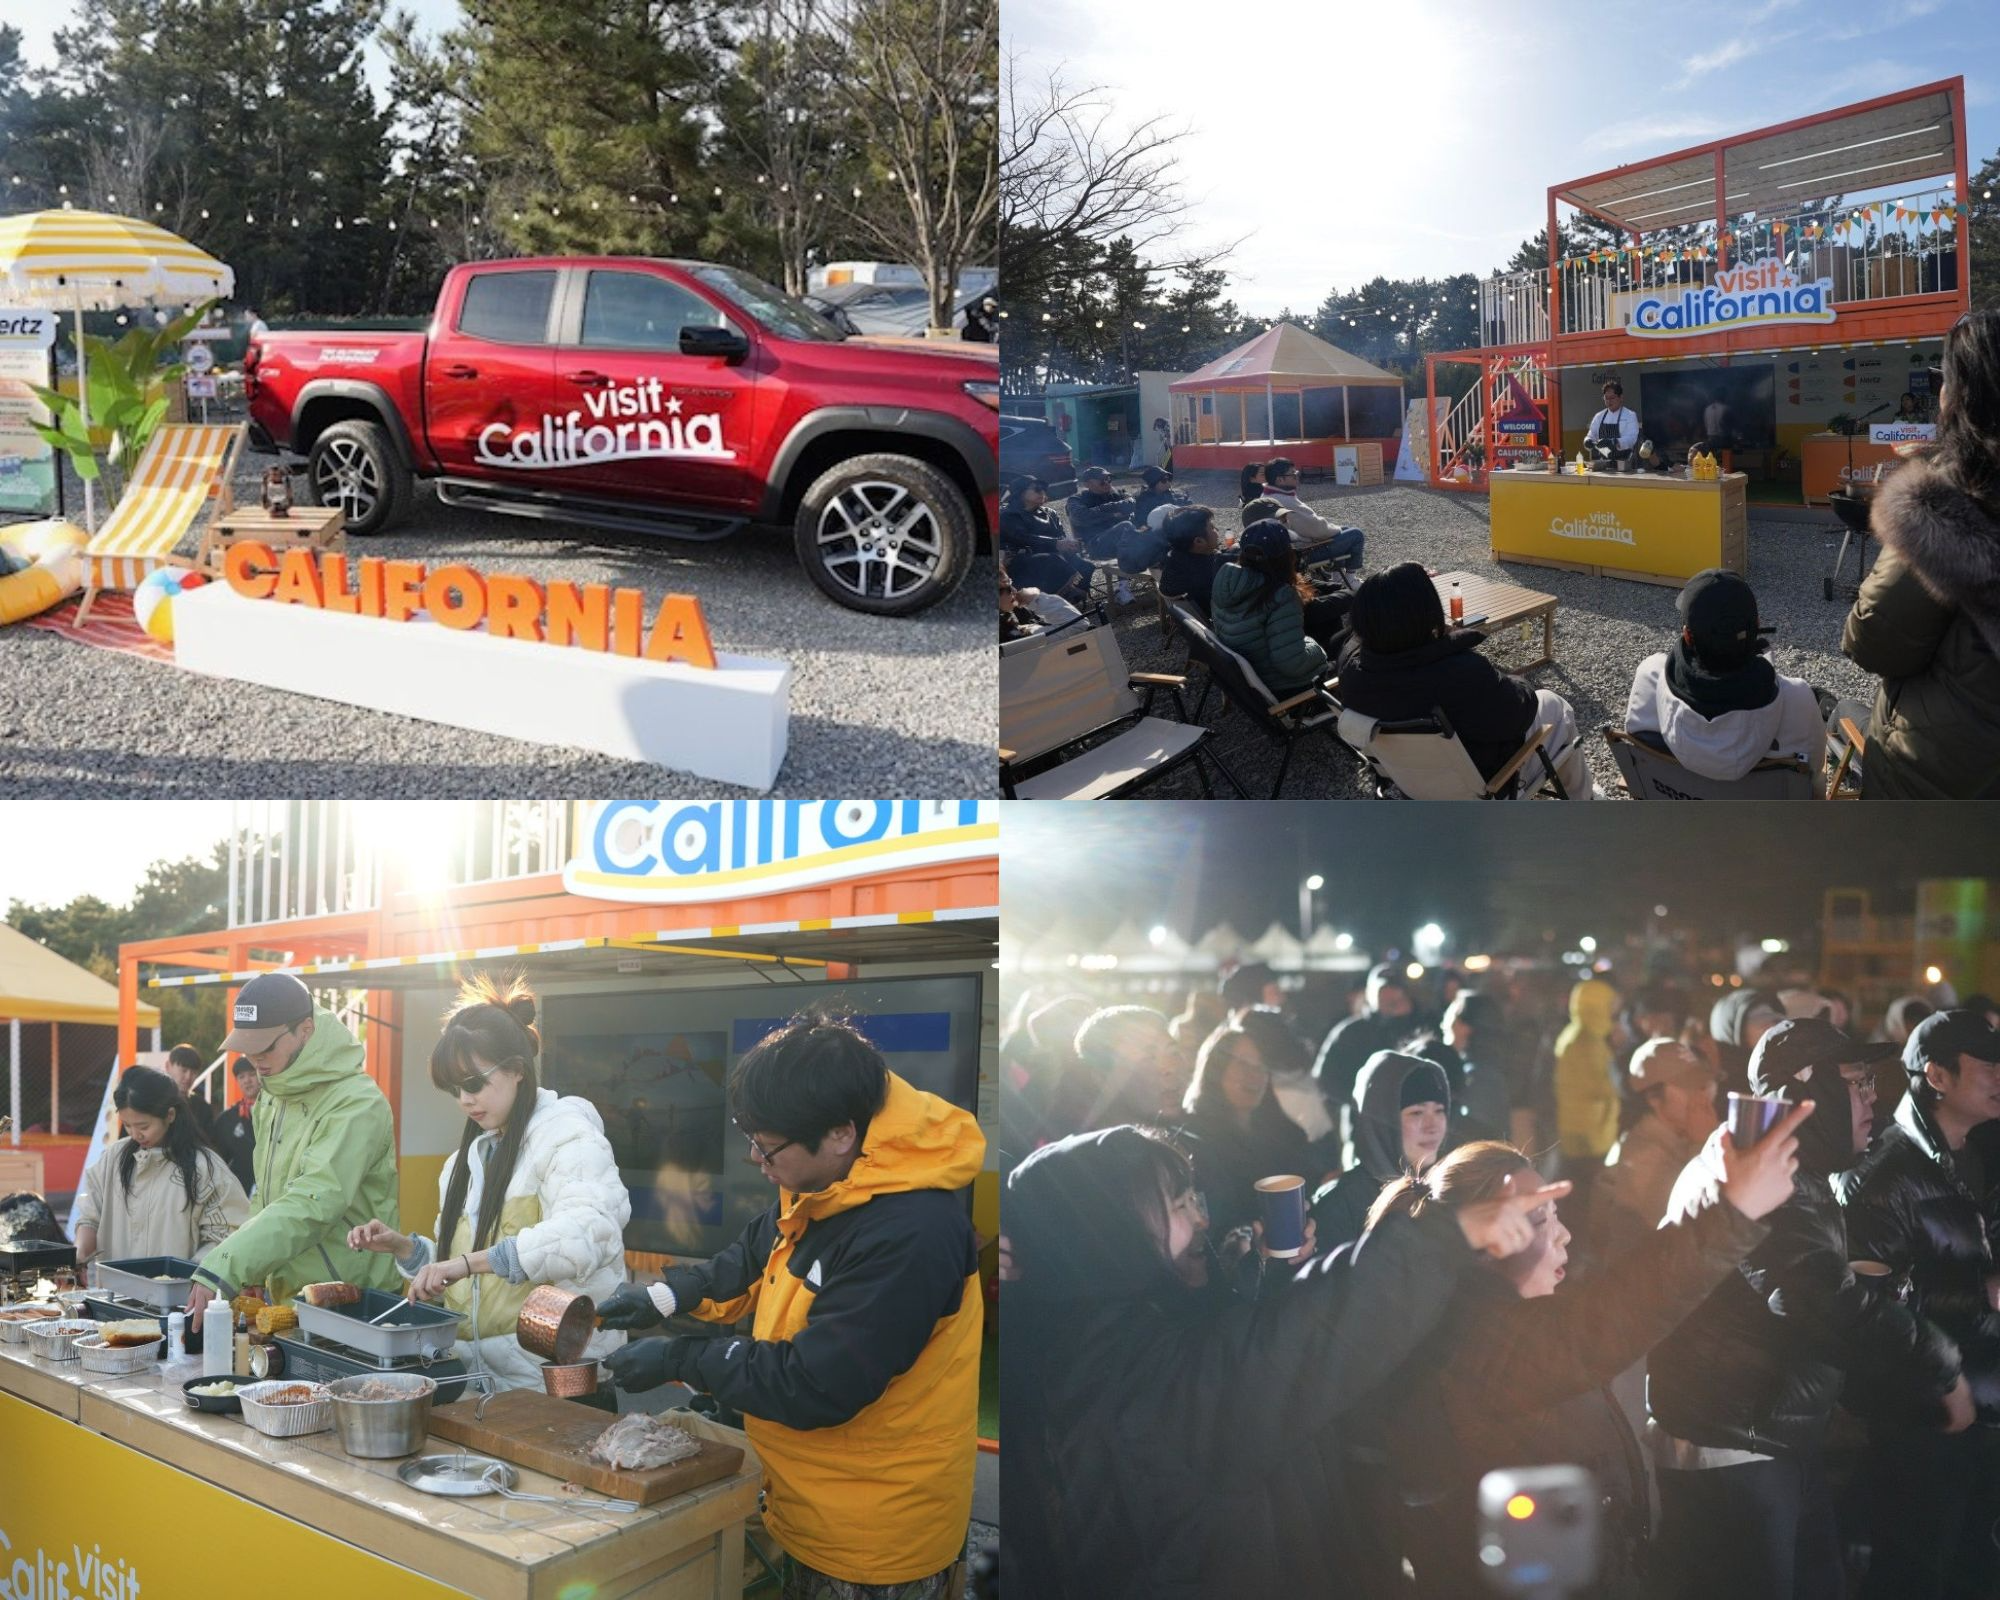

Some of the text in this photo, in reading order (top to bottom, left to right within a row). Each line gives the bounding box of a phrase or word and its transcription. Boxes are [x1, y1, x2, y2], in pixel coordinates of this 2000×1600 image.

[1718, 261, 1780, 293] visit
[1636, 286, 1822, 330] California
[583, 376, 663, 418] visit
[478, 413, 723, 464] California
[1900, 425, 1918, 434] visit
[1551, 517, 1633, 543] California
[1589, 511, 1616, 525] visit
[223, 539, 718, 669] CALIFORNIA
